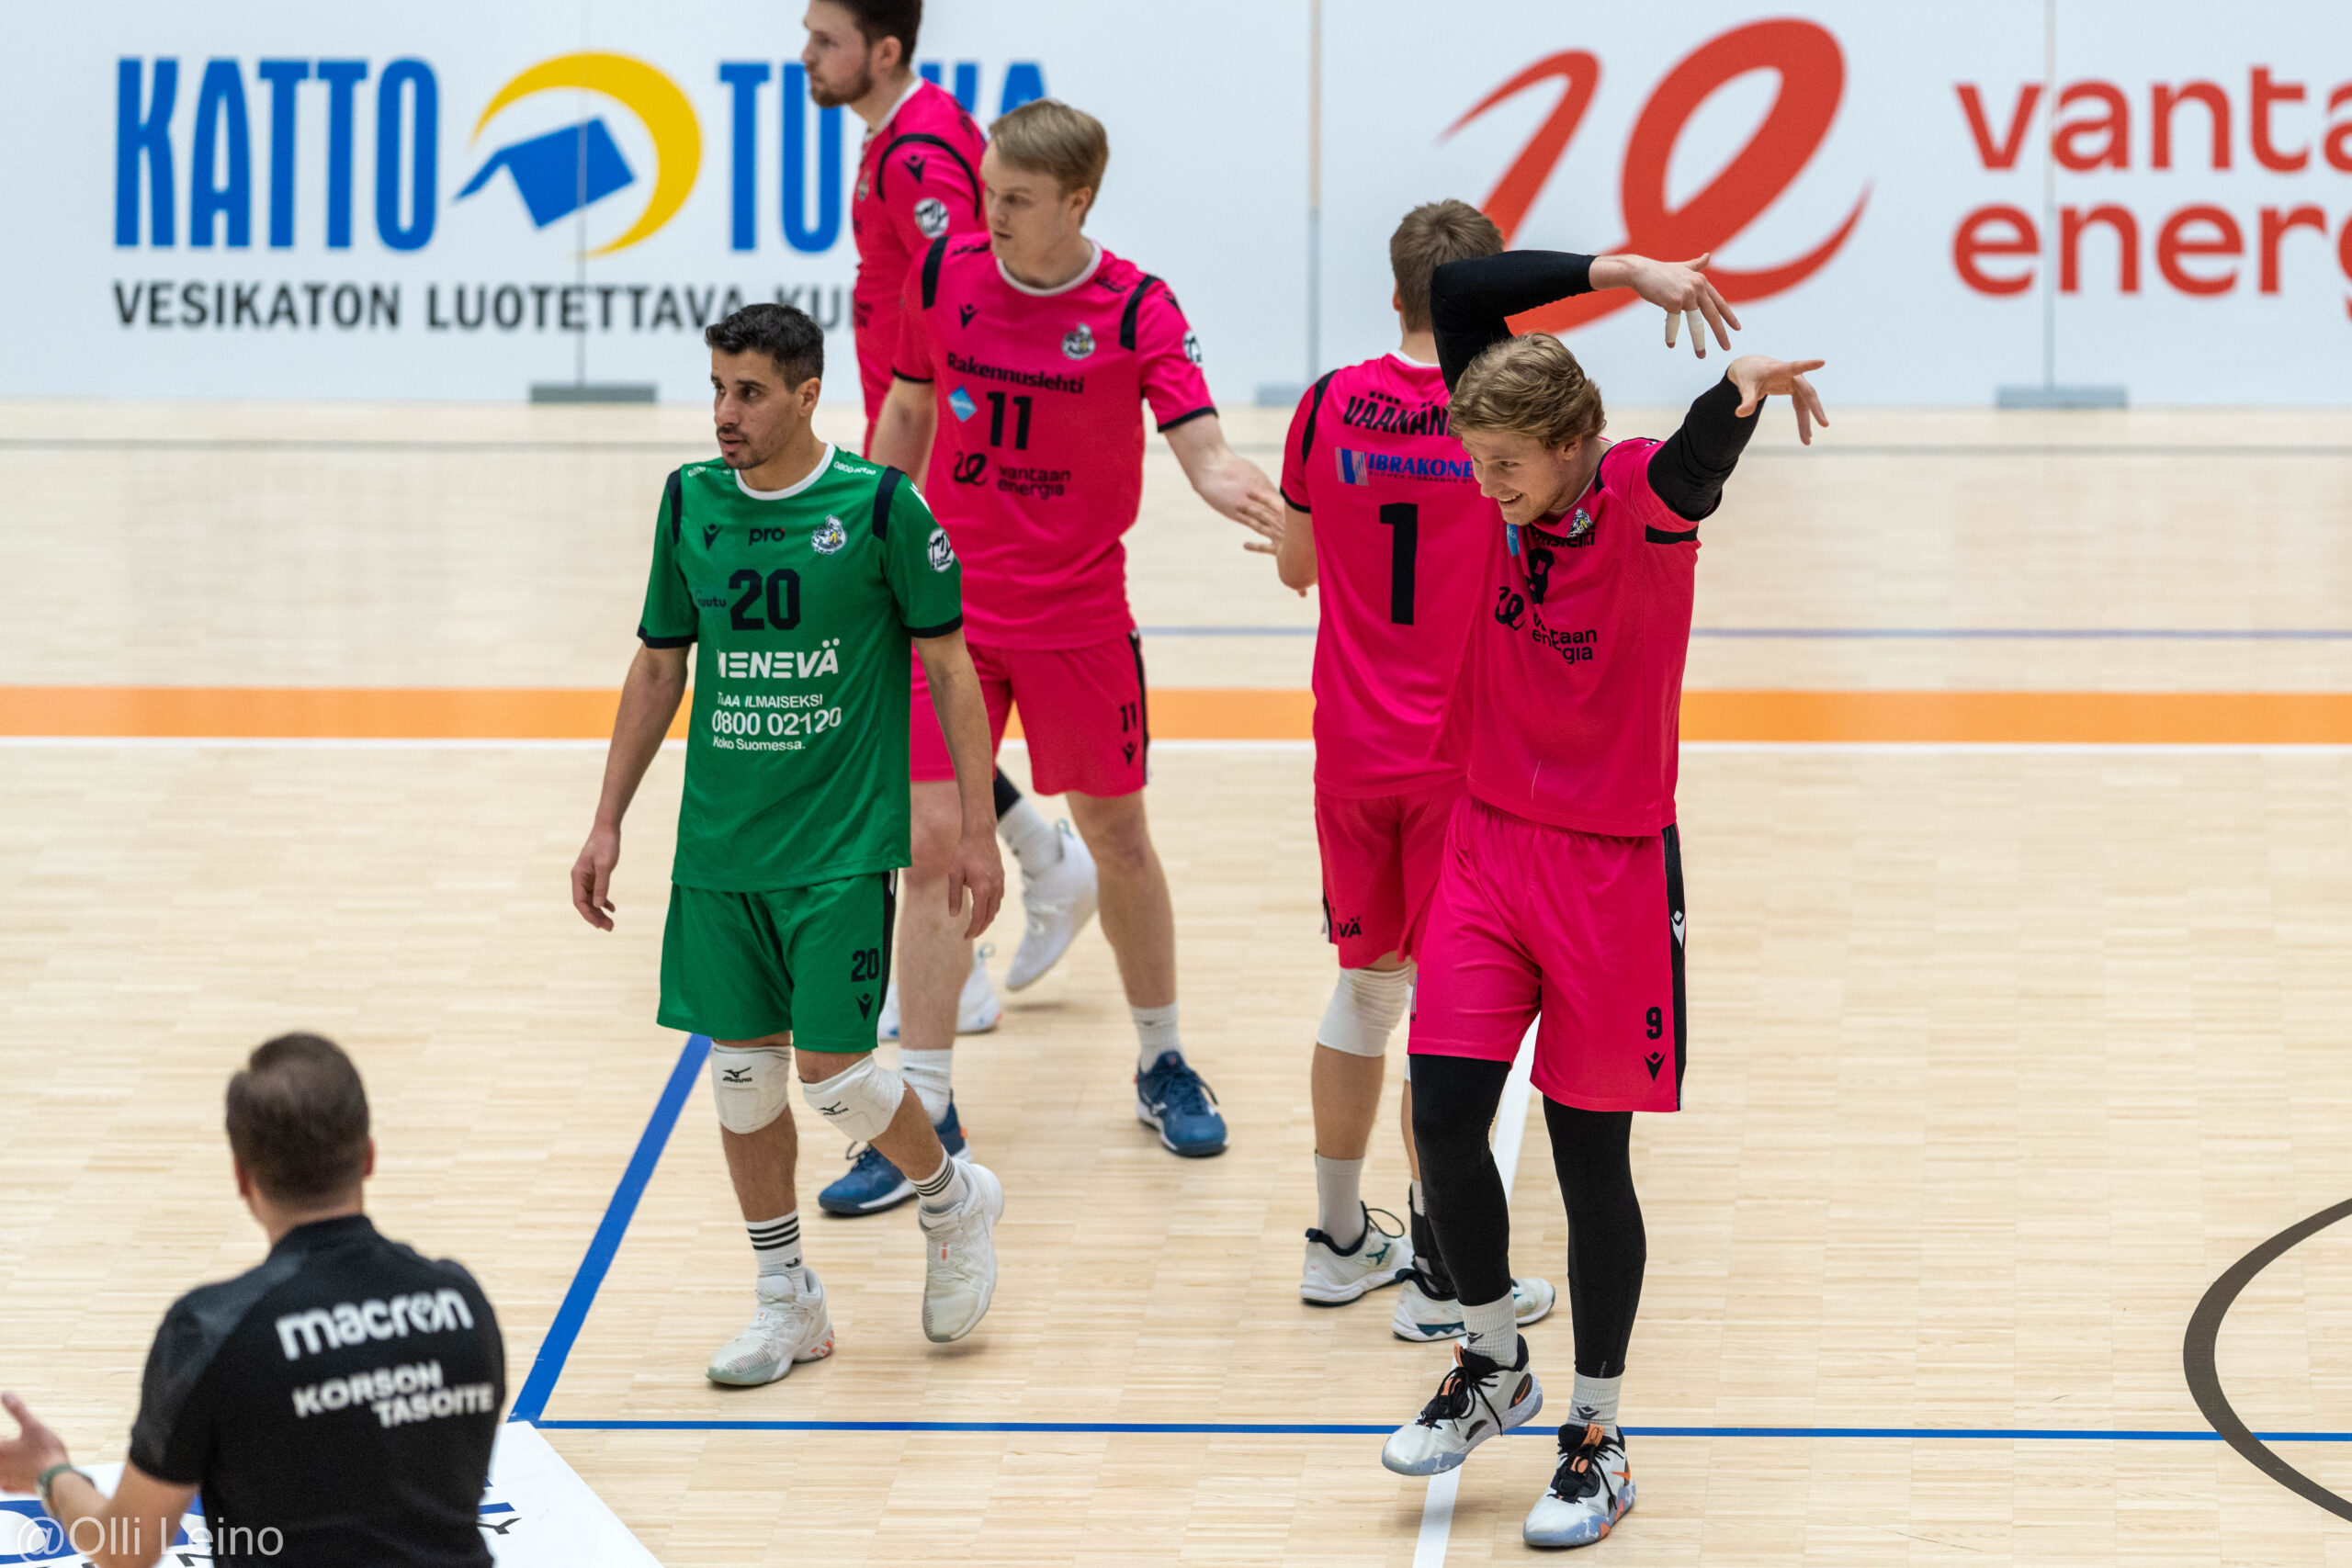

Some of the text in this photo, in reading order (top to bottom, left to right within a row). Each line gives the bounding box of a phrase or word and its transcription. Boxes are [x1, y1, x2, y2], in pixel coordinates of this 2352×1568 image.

[115, 58, 439, 251] KATTO
[1951, 203, 2352, 323] ener
[114, 282, 401, 331] VESIKATON
[427, 284, 743, 332] LUOTETTAVA
[947, 351, 1085, 394] Rakennuslehti
[987, 391, 1033, 450] 11
[1343, 390, 1453, 437] VÄÄNÄN
[997, 478, 1065, 501] energia
[998, 465, 1071, 481] vantaan
[748, 526, 786, 547] pro
[1380, 502, 1419, 626] 1
[729, 569, 800, 631] 20
[1533, 613, 1598, 644] vtaan
[712, 706, 842, 737] 0800 02120
[745, 694, 823, 708] ILMAISEKSI
[1120, 703, 1137, 733] 11
[713, 735, 806, 750] Koko Suomessa.
[851, 947, 879, 983] 20
[1645, 1006, 1663, 1040] 9
[276, 1288, 475, 1360] macron
[292, 1359, 443, 1418] KORSON
[372, 1382, 494, 1428] TASOITE
